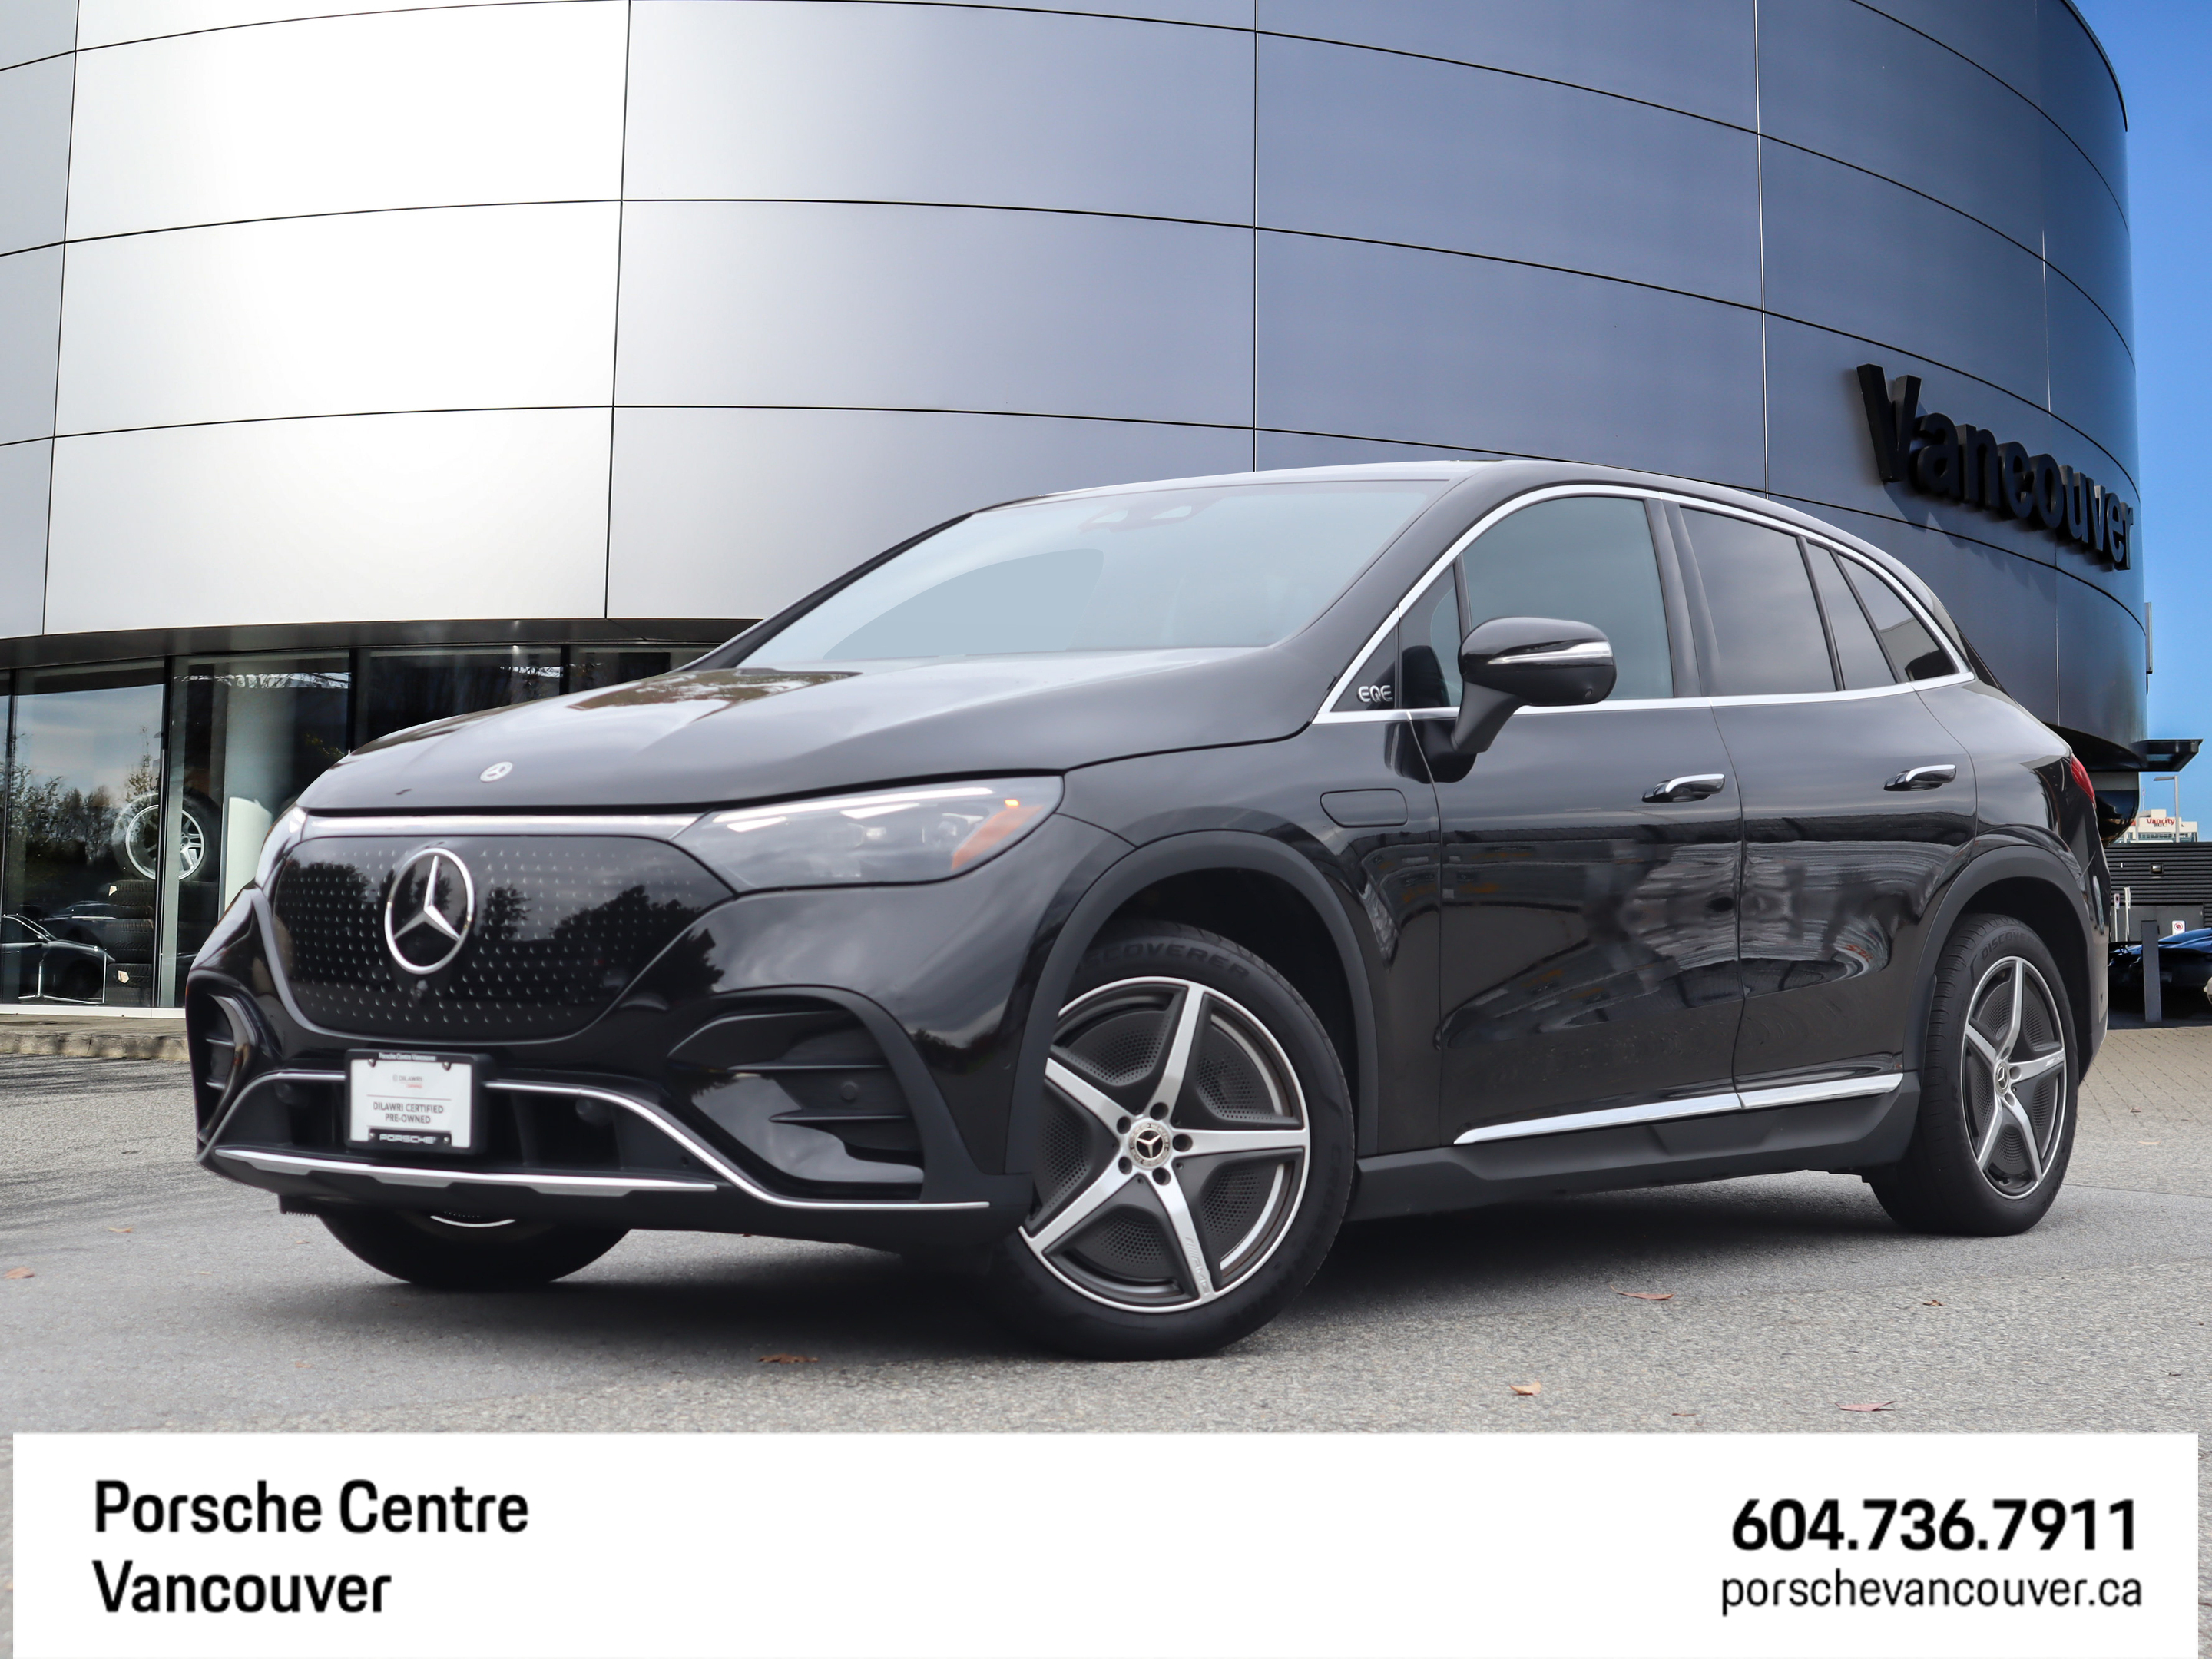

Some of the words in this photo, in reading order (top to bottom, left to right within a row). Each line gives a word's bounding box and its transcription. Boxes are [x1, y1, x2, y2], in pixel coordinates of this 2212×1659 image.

[1856, 363, 2134, 571] Vancouver
[1357, 684, 1393, 703] EQE
[373, 1101, 404, 1112] DILAWRI
[406, 1103, 444, 1114] CERTIFIED
[385, 1113, 431, 1124] PRE-OWNED
[379, 1133, 438, 1144] PORSCHE
